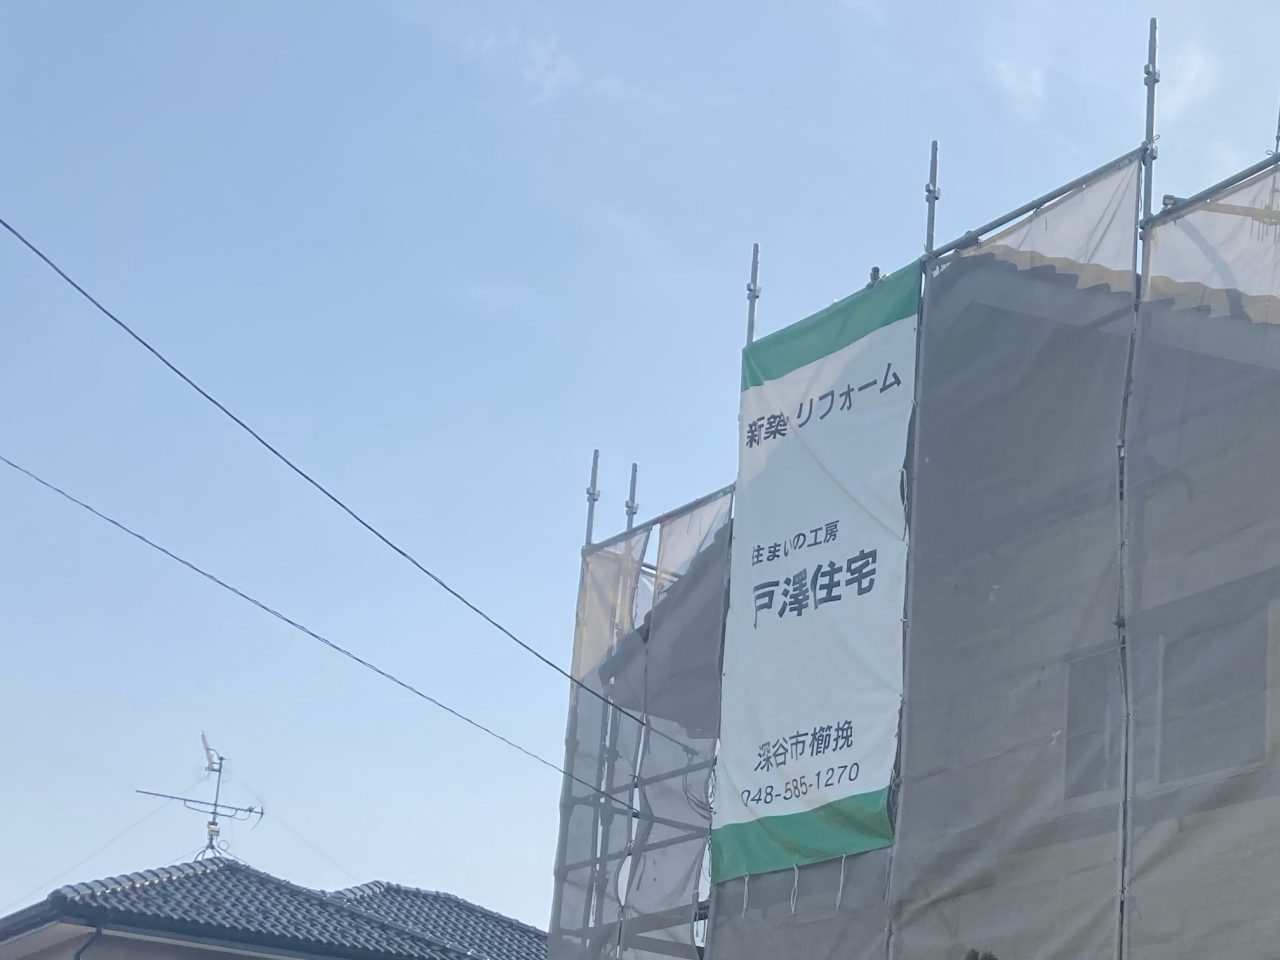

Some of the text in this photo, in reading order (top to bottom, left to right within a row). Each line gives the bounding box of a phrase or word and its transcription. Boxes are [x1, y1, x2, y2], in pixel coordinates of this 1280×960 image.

[746, 363, 901, 448] 新築 リフォーム
[752, 520, 840, 567] 住まいの工房
[753, 549, 877, 630] 戸澤住宅
[741, 762, 860, 807] 048-585-1270
